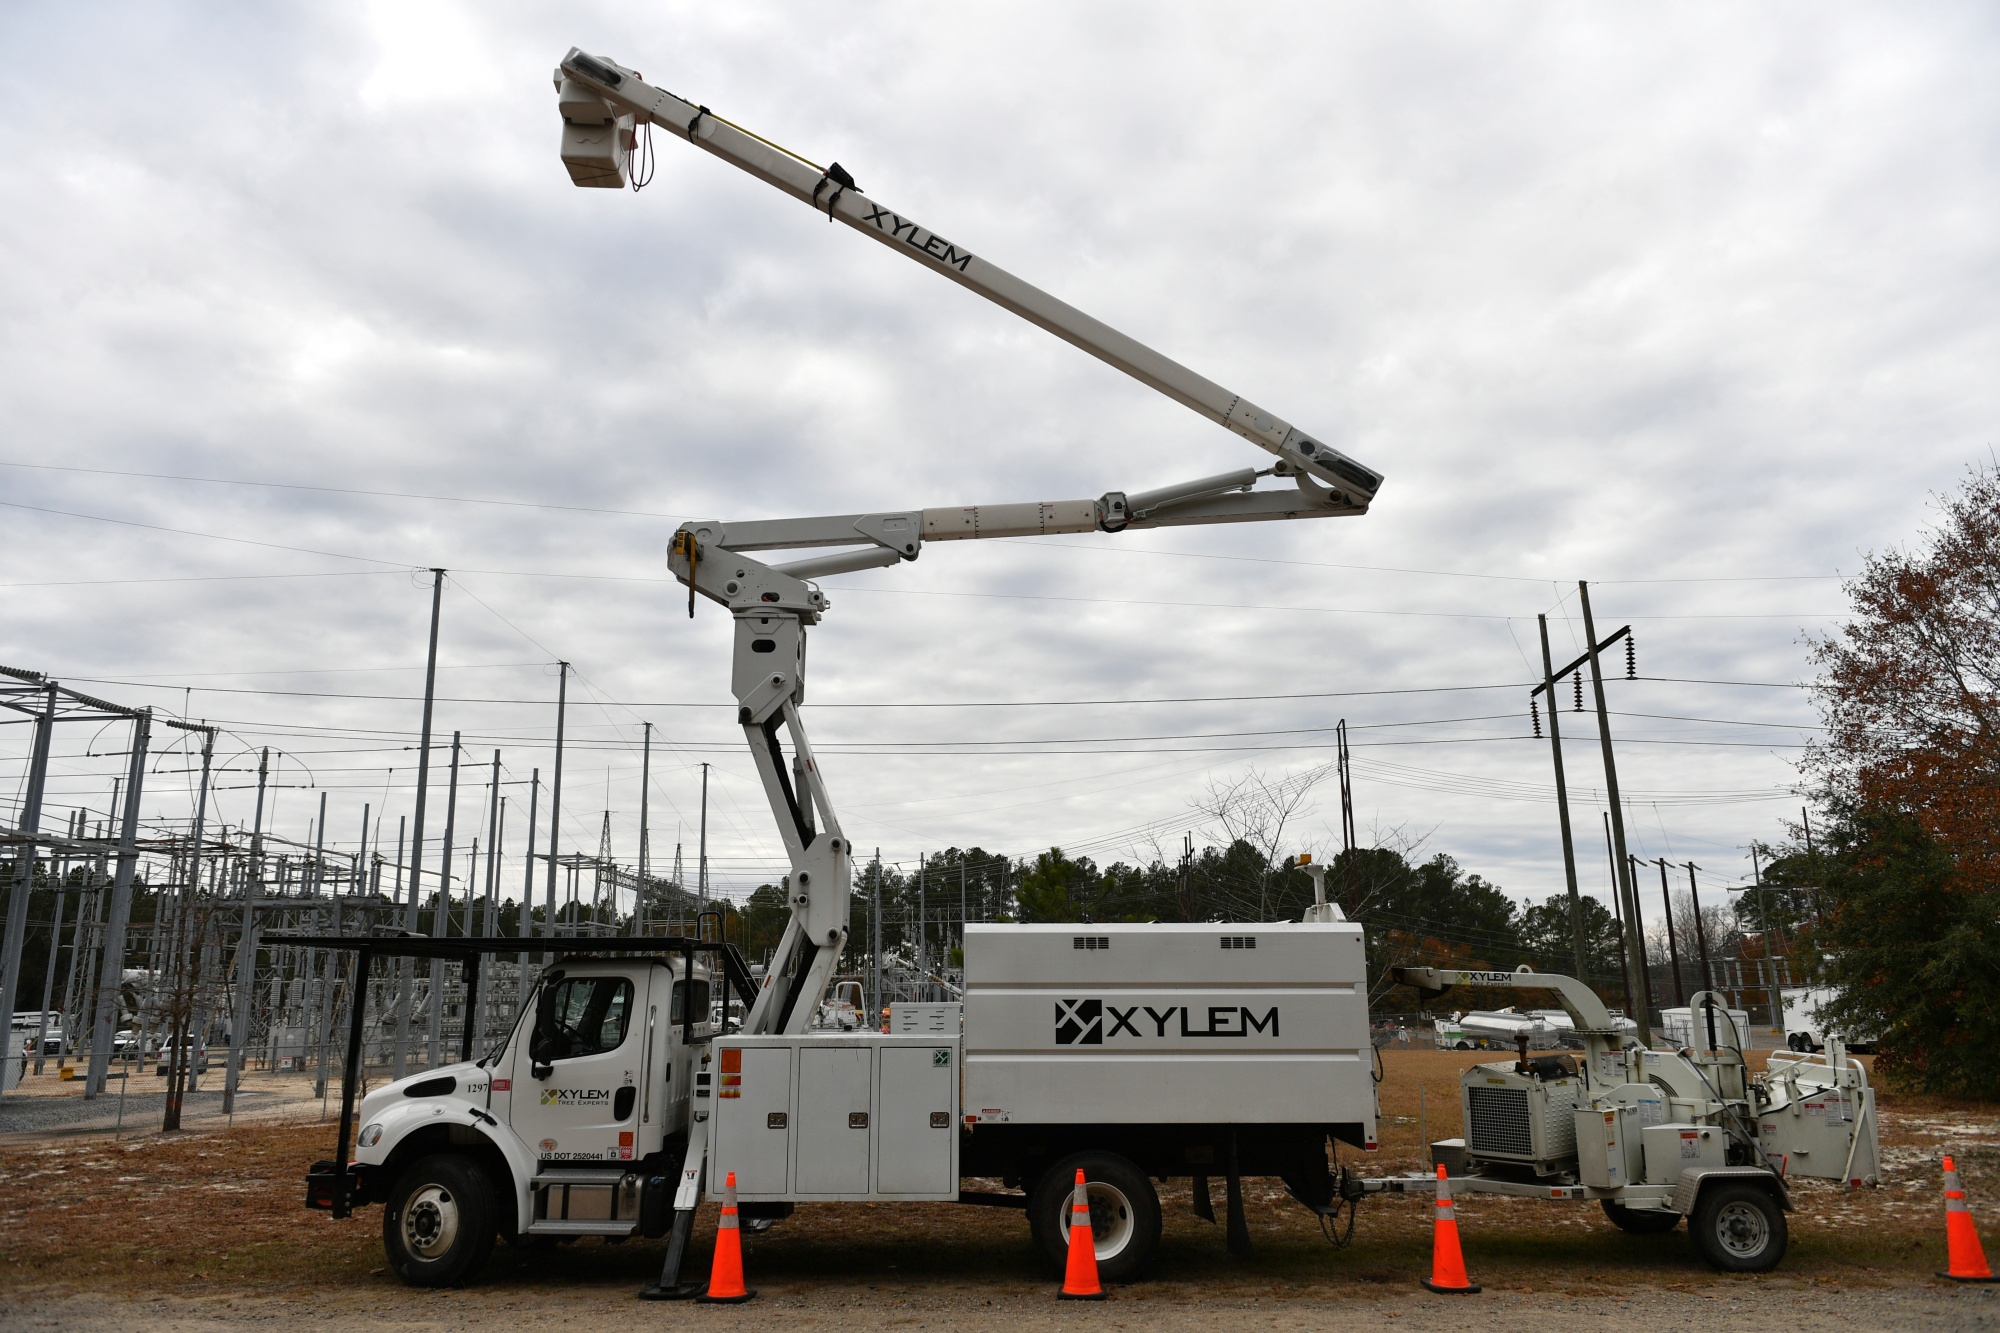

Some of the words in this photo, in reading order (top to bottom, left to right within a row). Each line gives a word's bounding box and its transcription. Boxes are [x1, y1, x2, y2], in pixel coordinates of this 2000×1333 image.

[862, 203, 972, 272] XYLEM
[1469, 972, 1512, 982] XYLEM
[1105, 1006, 1280, 1037] XYLEM
[467, 1083, 488, 1093] 1297
[558, 1089, 609, 1100] XYLEM
[540, 1152, 552, 1160] US
[554, 1152, 571, 1160] DOT
[572, 1152, 603, 1160] 2520441
